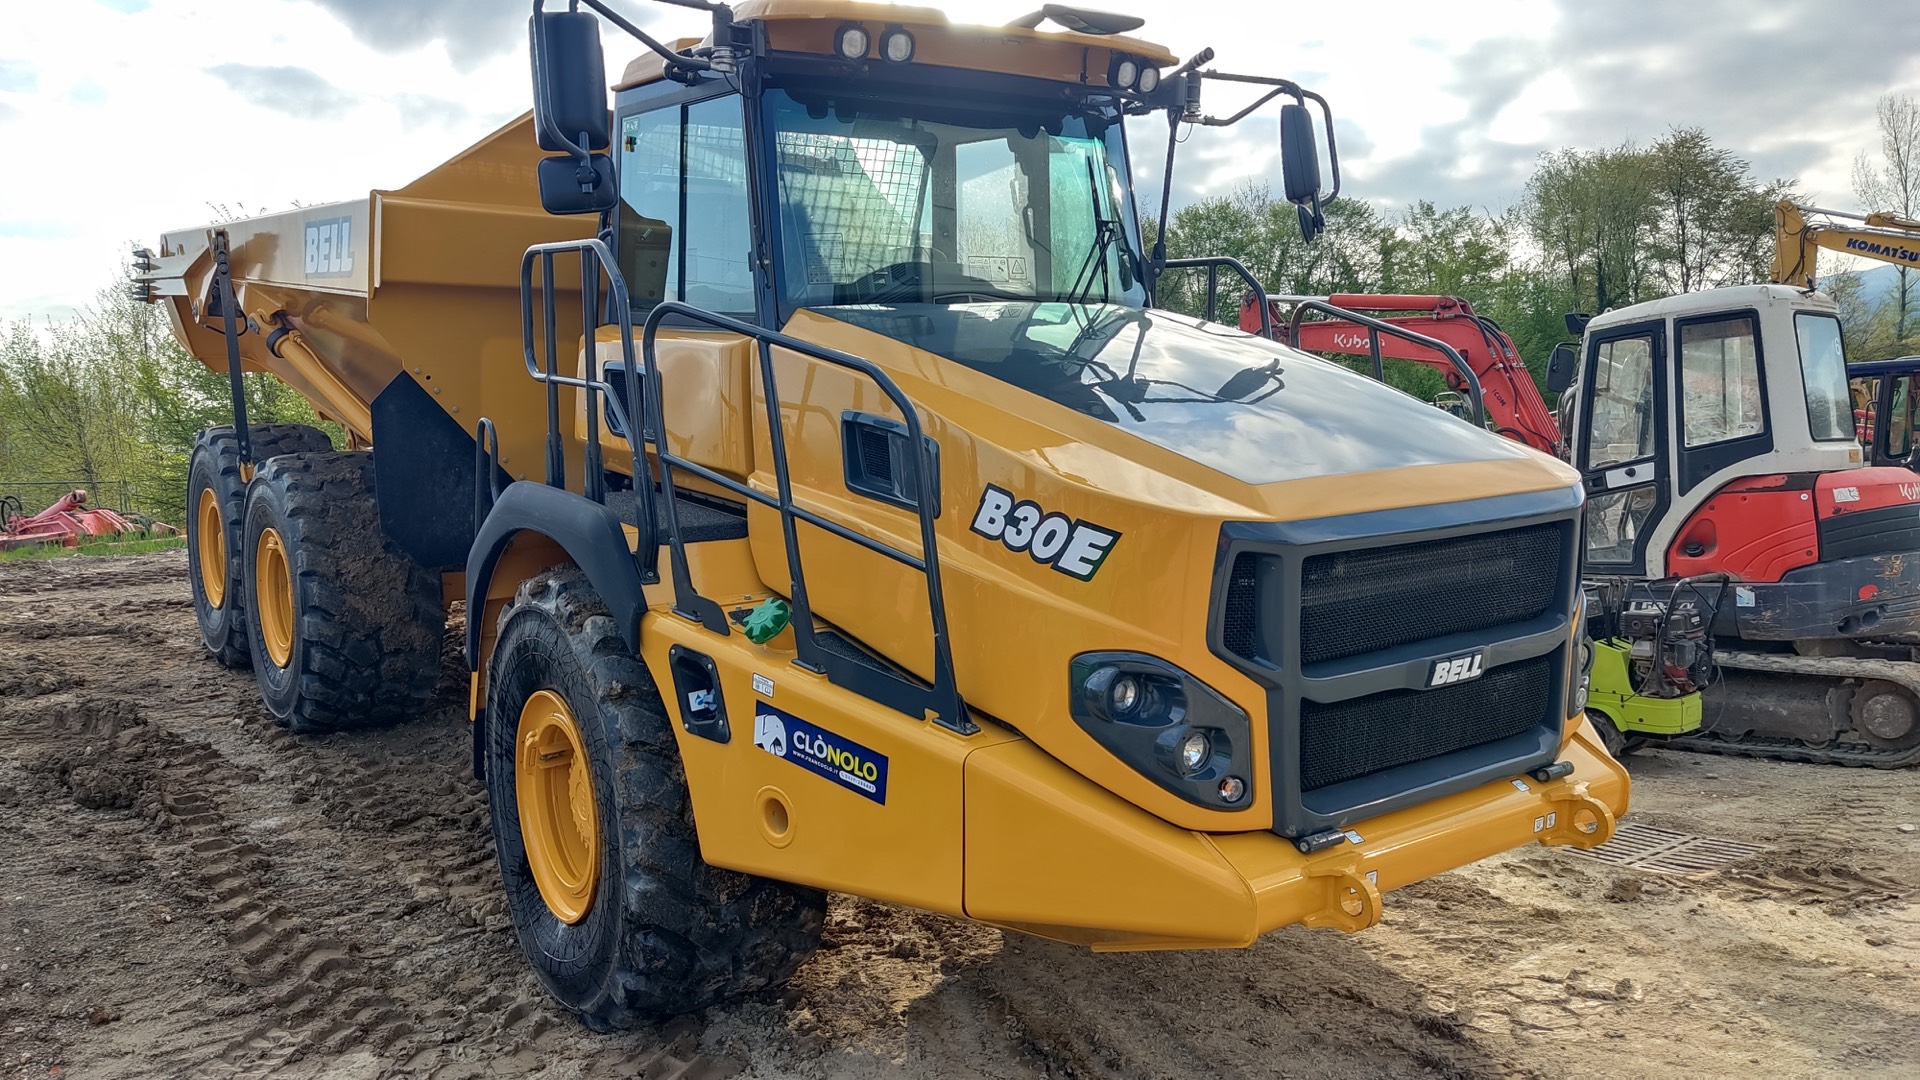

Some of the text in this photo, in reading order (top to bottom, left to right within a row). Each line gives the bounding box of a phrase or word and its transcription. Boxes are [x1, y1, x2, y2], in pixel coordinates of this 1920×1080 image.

[305, 220, 353, 275] BELL
[1846, 237, 1920, 262] KOMATSU
[972, 486, 1117, 579] B30E
[1430, 654, 1482, 687] BELL
[792, 730, 878, 782] CLÒNOLO
